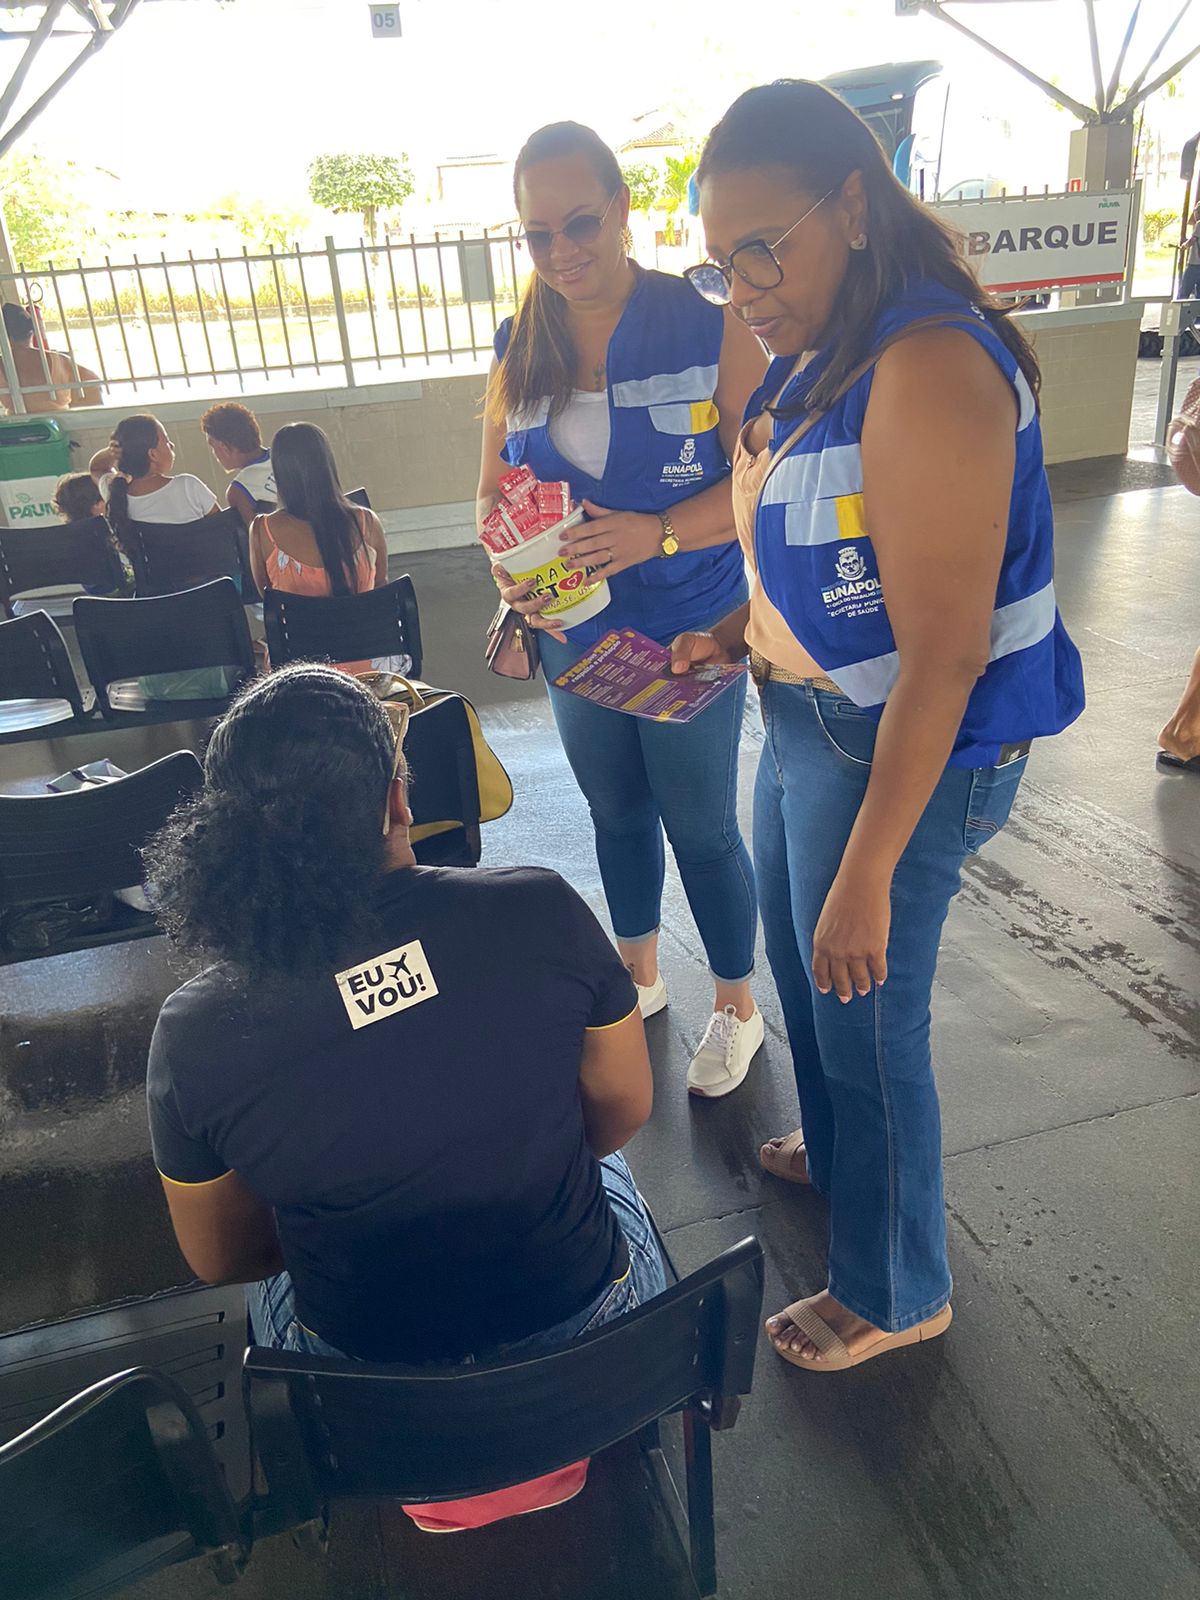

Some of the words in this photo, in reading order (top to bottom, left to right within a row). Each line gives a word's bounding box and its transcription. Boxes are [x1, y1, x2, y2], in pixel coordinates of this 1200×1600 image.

[374, 12, 395, 28] 05
[958, 221, 1118, 256] BARQUE
[9, 502, 56, 519] PAUM
[822, 578, 882, 604] EUNÁPOL
[827, 602, 862, 617] ECRETARIA
[864, 597, 885, 607] MUNIC
[847, 610, 856, 618] DE
[348, 965, 384, 995] EU
[355, 972, 427, 1016] VOU!
